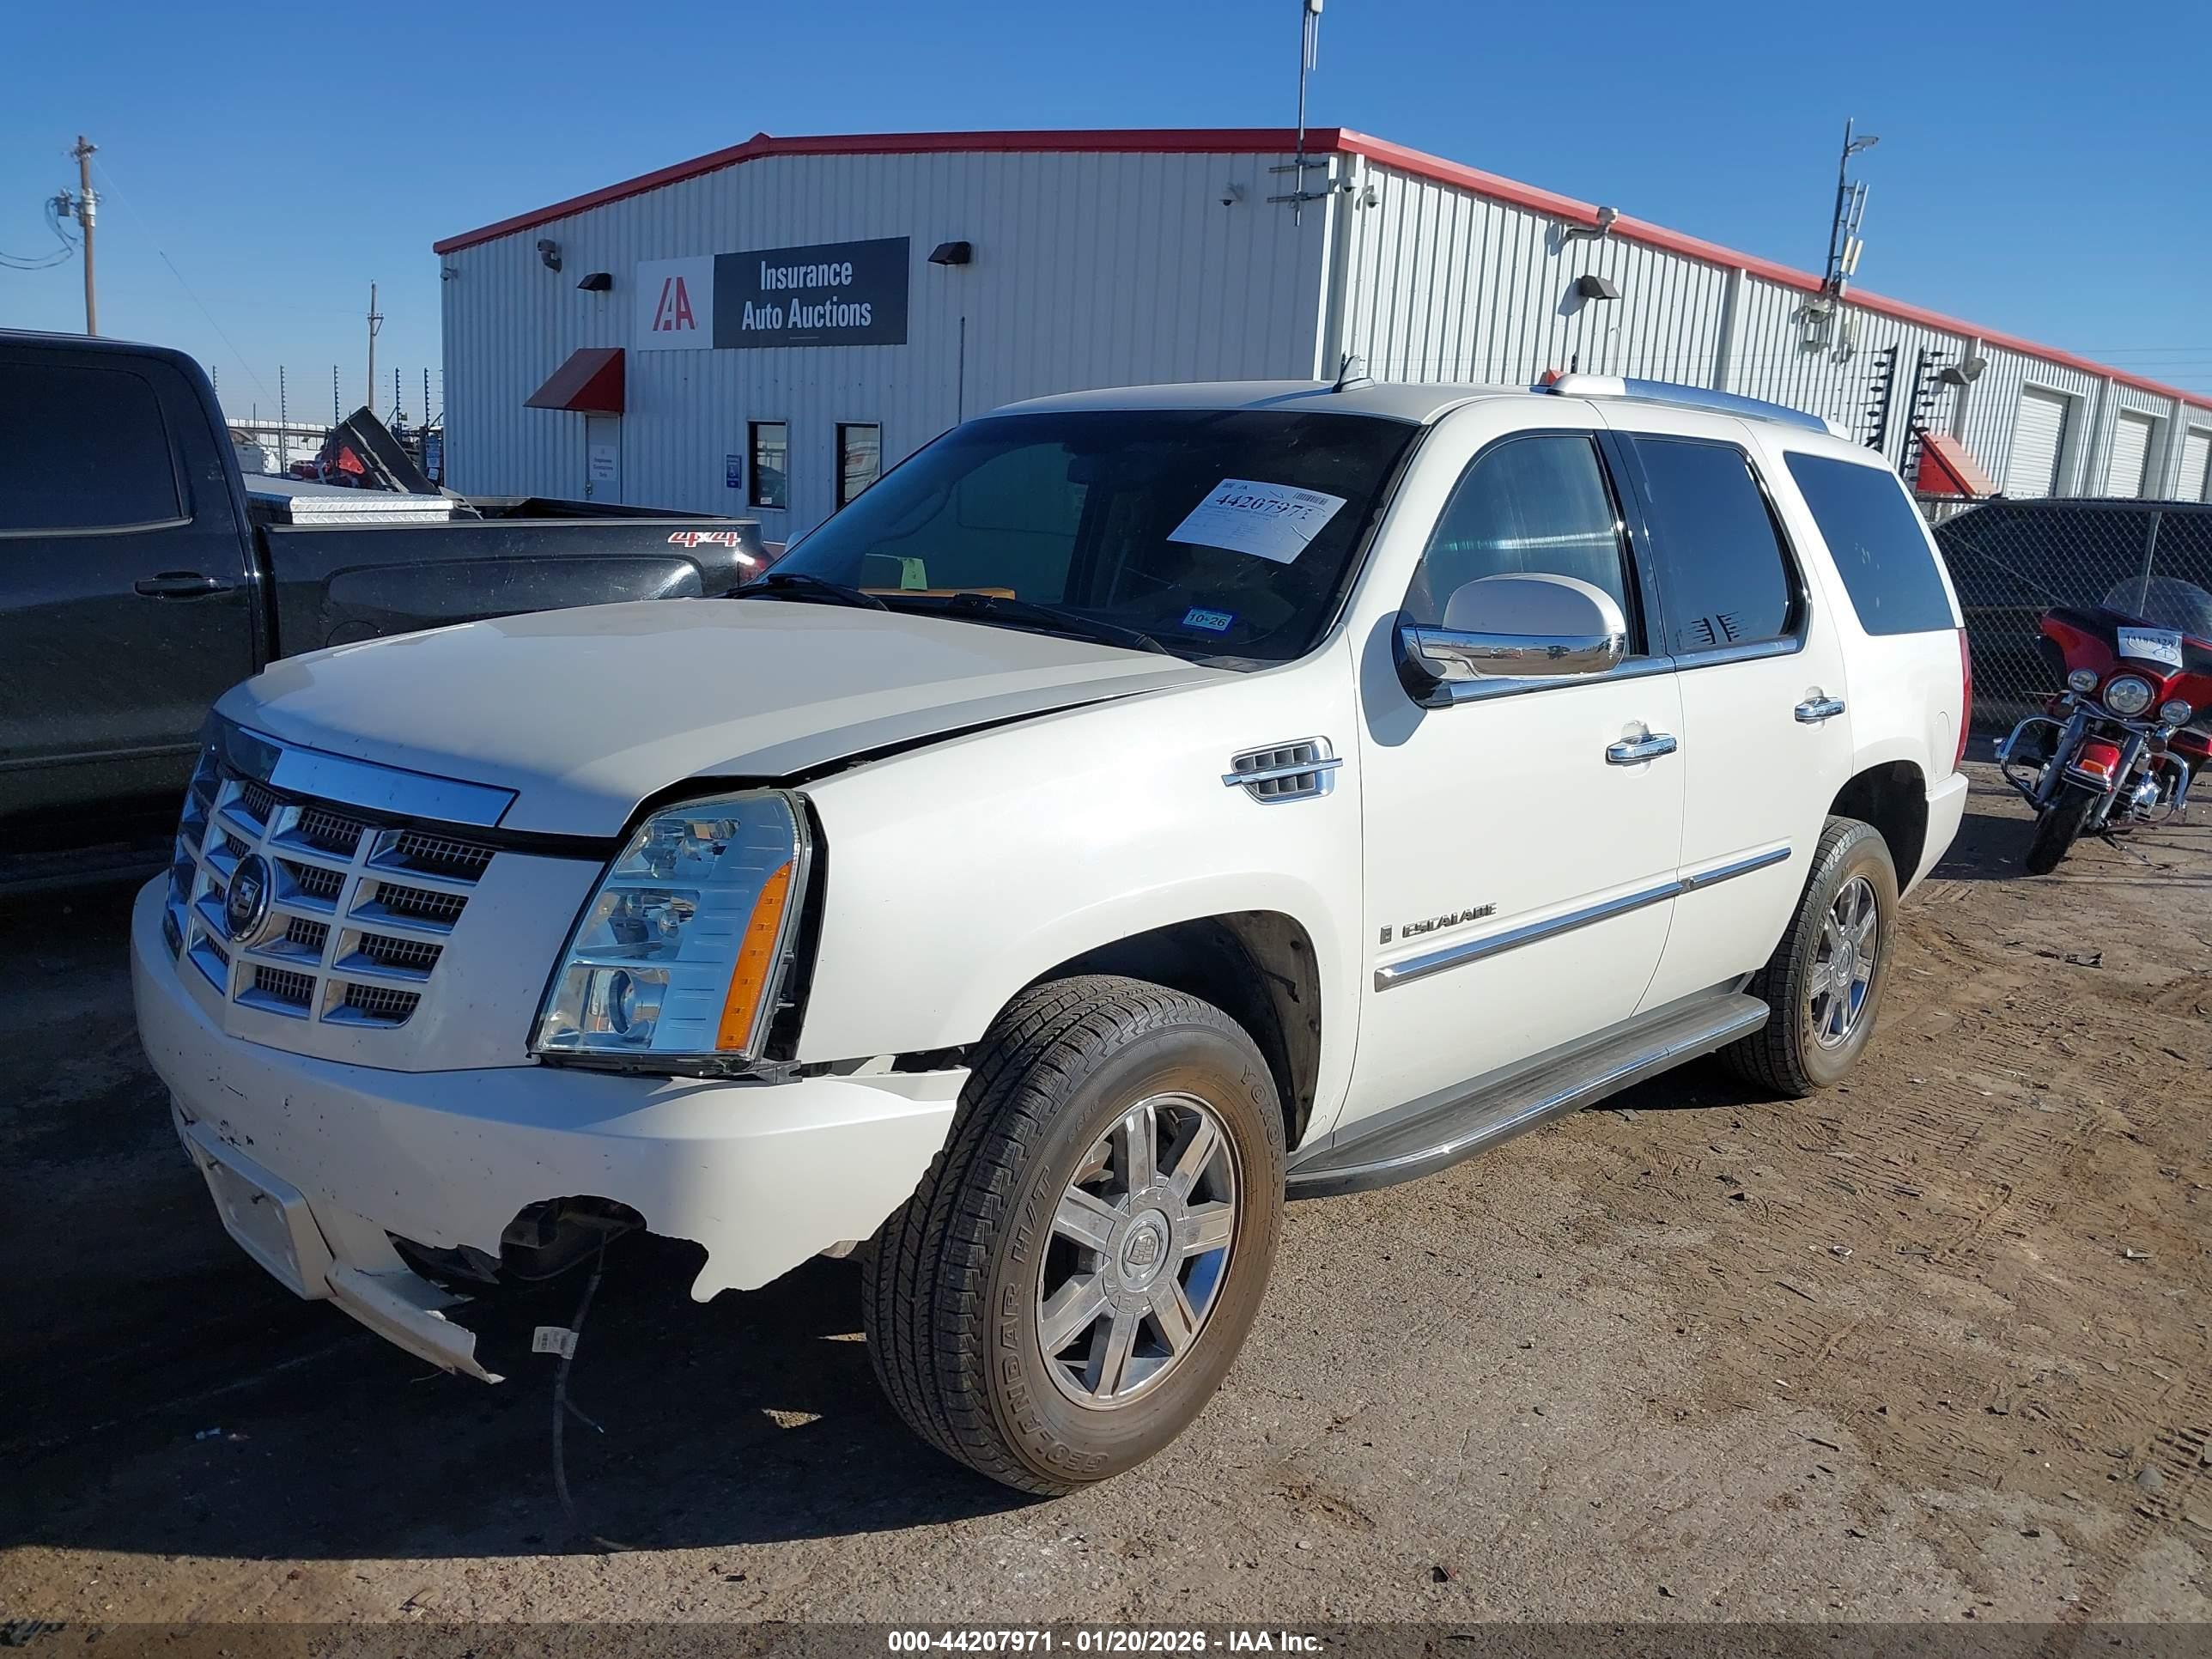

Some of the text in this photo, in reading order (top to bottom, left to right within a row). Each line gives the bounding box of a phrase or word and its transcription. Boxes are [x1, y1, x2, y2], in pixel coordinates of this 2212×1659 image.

[760, 260, 853, 290] Insurance
[741, 295, 872, 331] Auto Auctions
[1215, 493, 1314, 520] 44207971
[1401, 902, 1498, 938] ESCALADE
